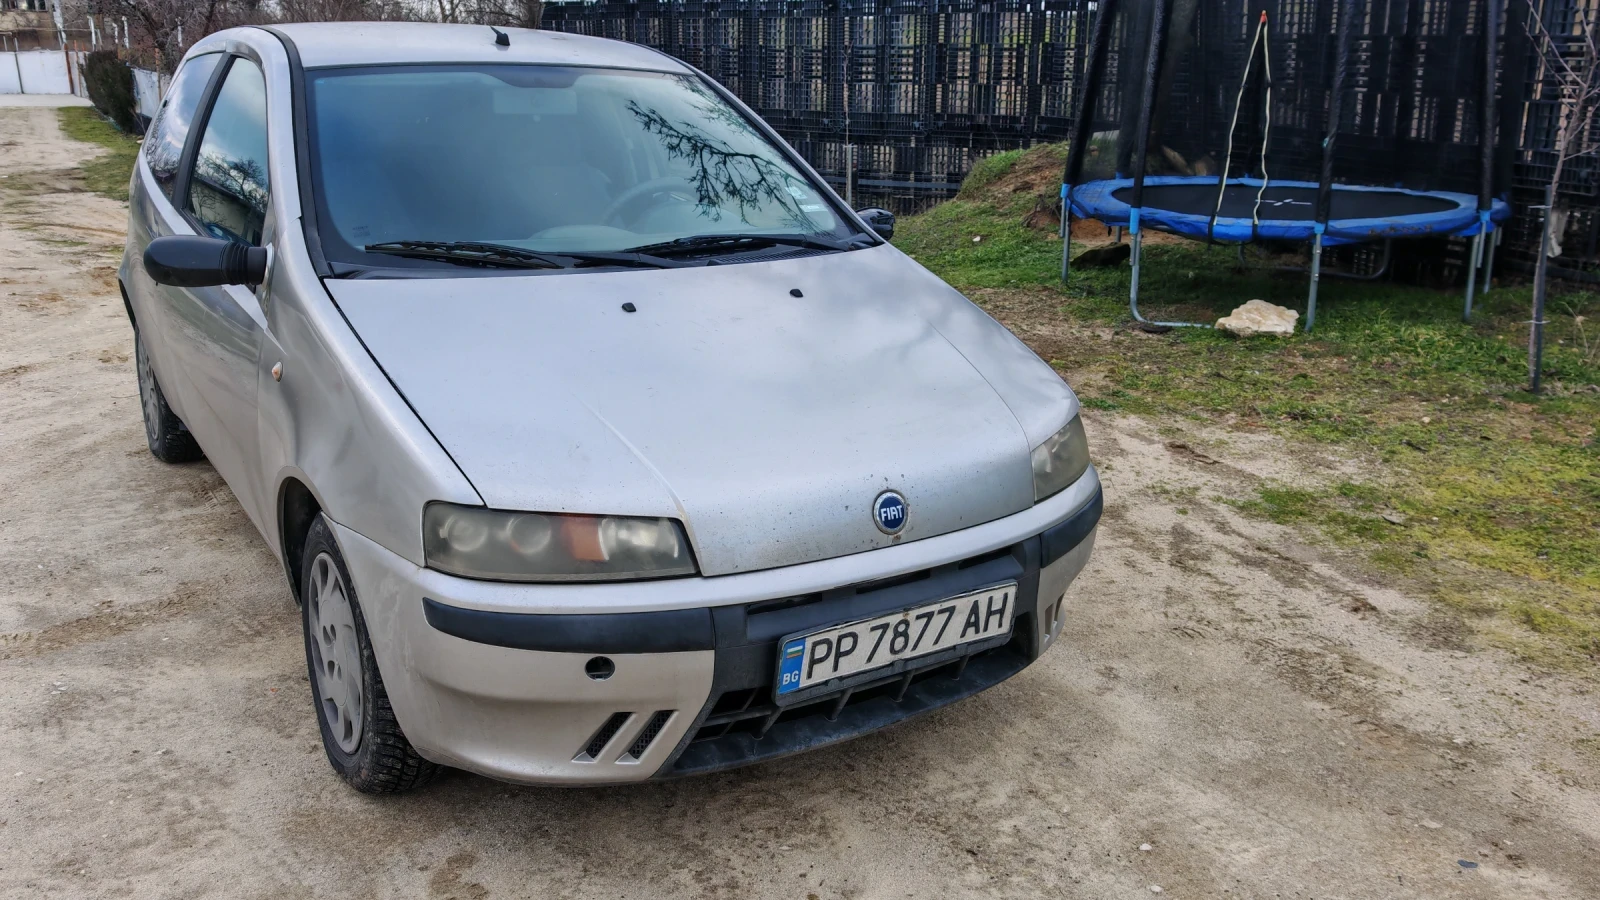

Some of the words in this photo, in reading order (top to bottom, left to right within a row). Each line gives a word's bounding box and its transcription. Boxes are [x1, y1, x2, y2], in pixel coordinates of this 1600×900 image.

[881, 505, 902, 521] FIAT
[806, 631, 858, 680] PP
[865, 605, 956, 664] 7877
[960, 592, 1008, 638] AH
[783, 670, 799, 685] BG
